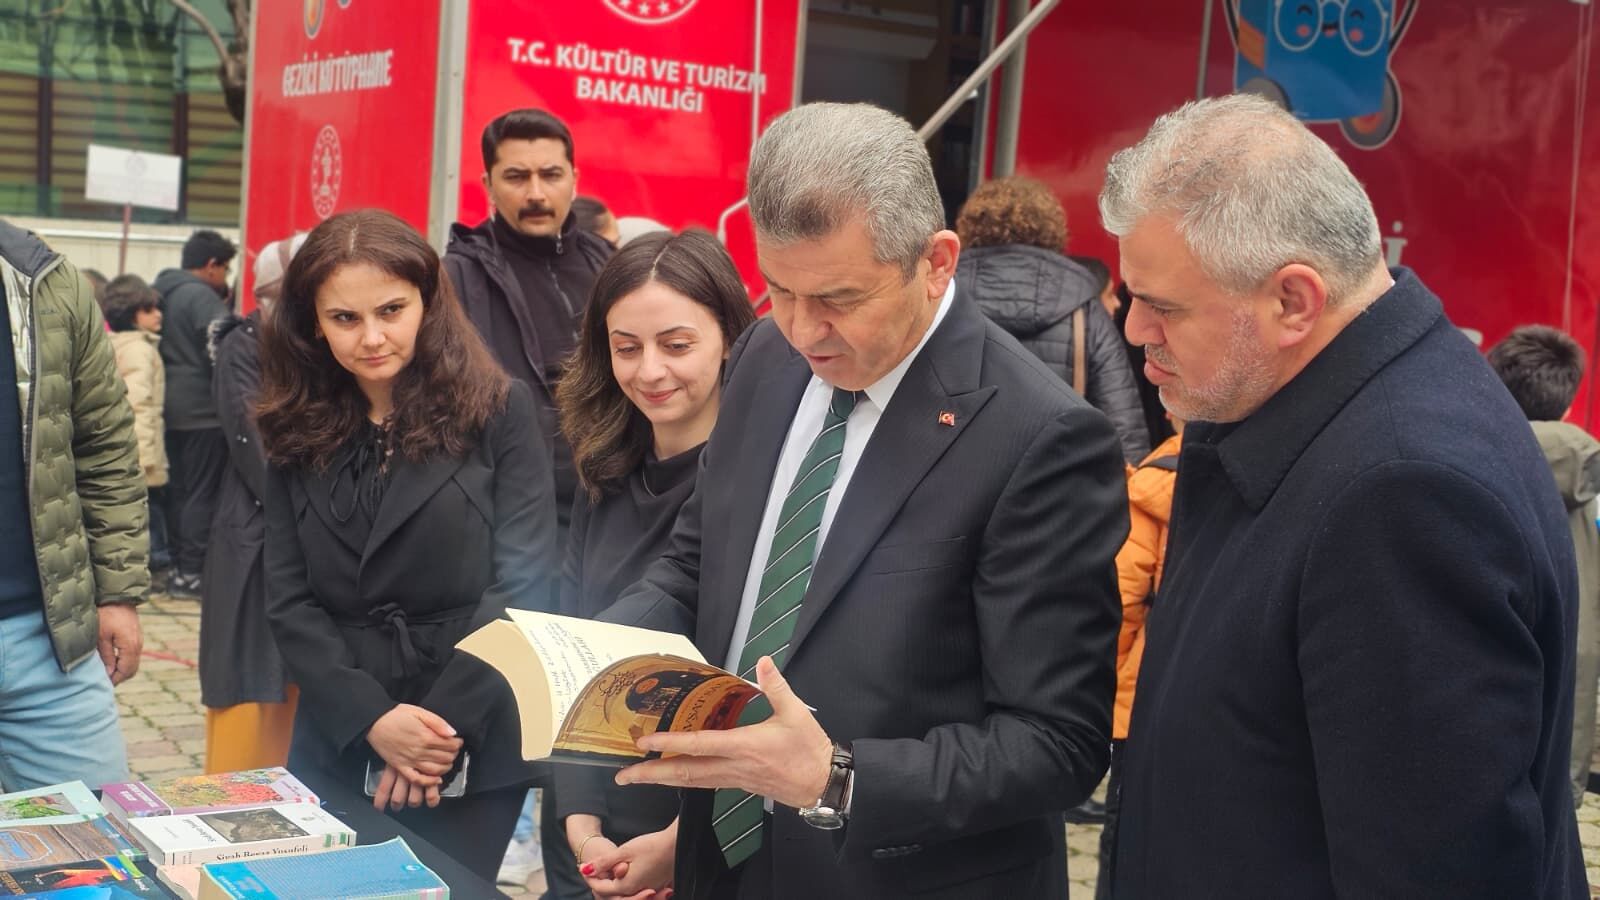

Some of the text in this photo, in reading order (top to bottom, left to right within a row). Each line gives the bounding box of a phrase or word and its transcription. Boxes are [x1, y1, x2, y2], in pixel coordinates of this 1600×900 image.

[507, 38, 767, 95] T.C. KÜLTÜR VE TURİZM
[575, 75, 704, 112] BAKANLIĞI
